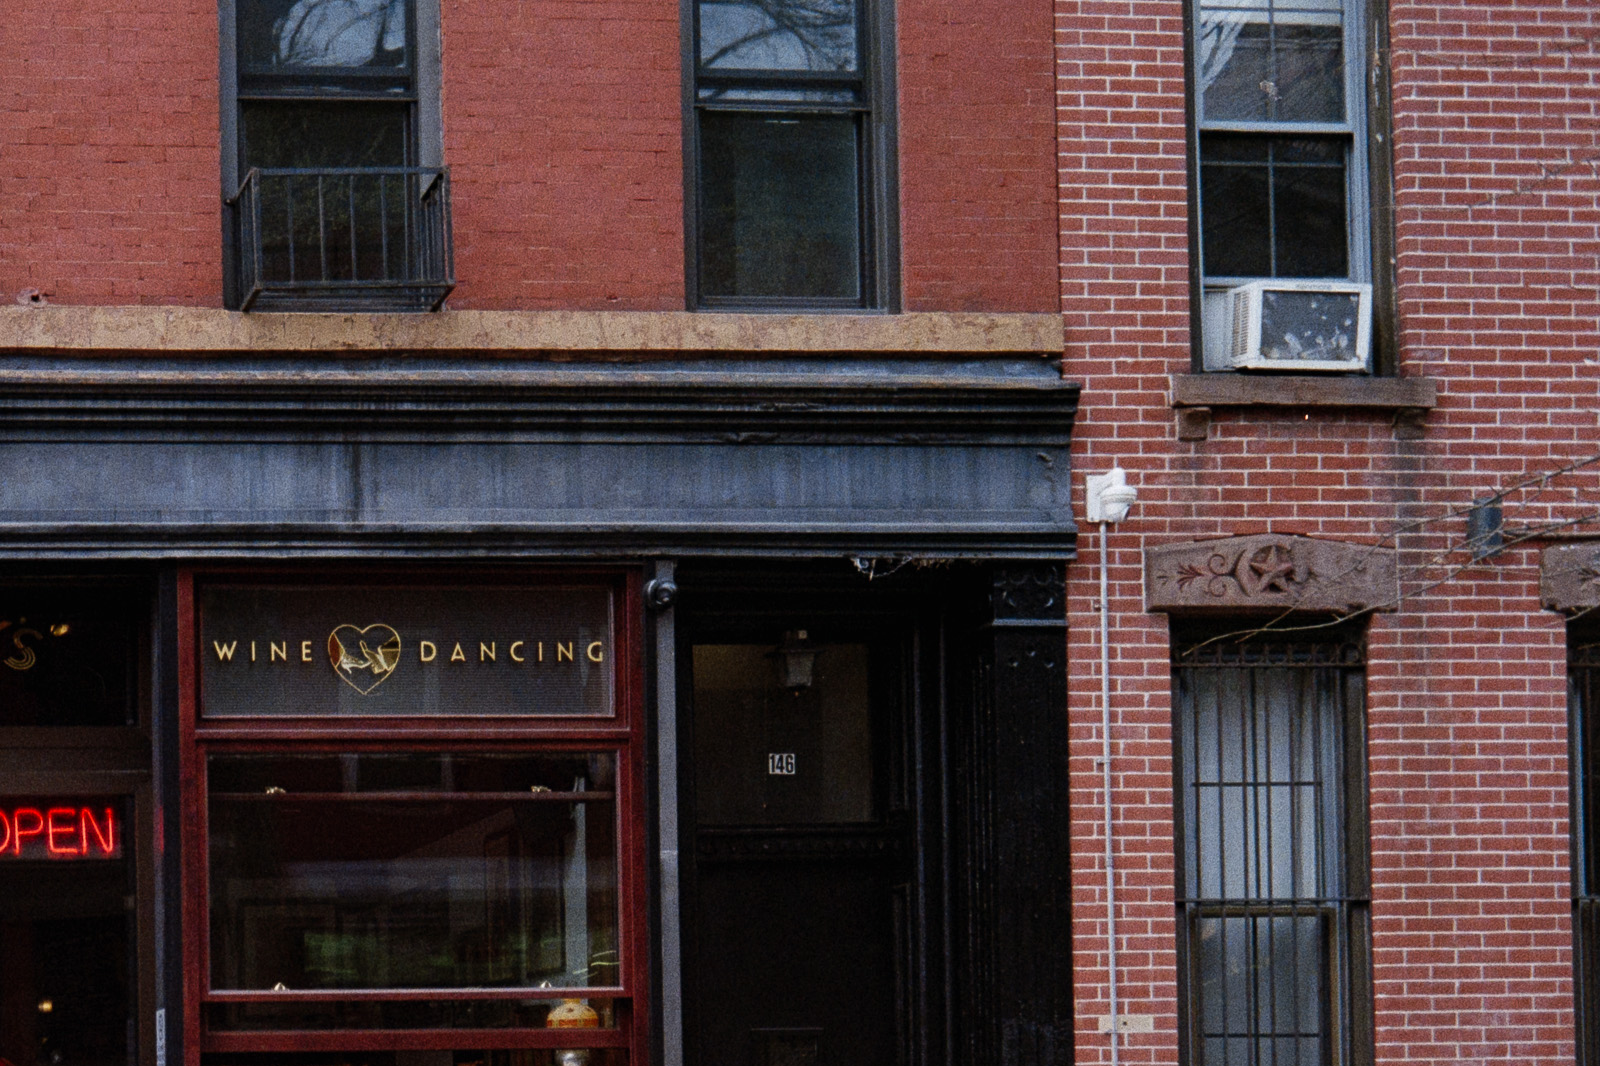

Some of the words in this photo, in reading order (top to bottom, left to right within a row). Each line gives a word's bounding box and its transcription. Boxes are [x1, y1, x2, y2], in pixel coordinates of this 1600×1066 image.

[213, 639, 314, 663] WINE
[419, 639, 605, 664] DANCING
[768, 753, 796, 775] 146
